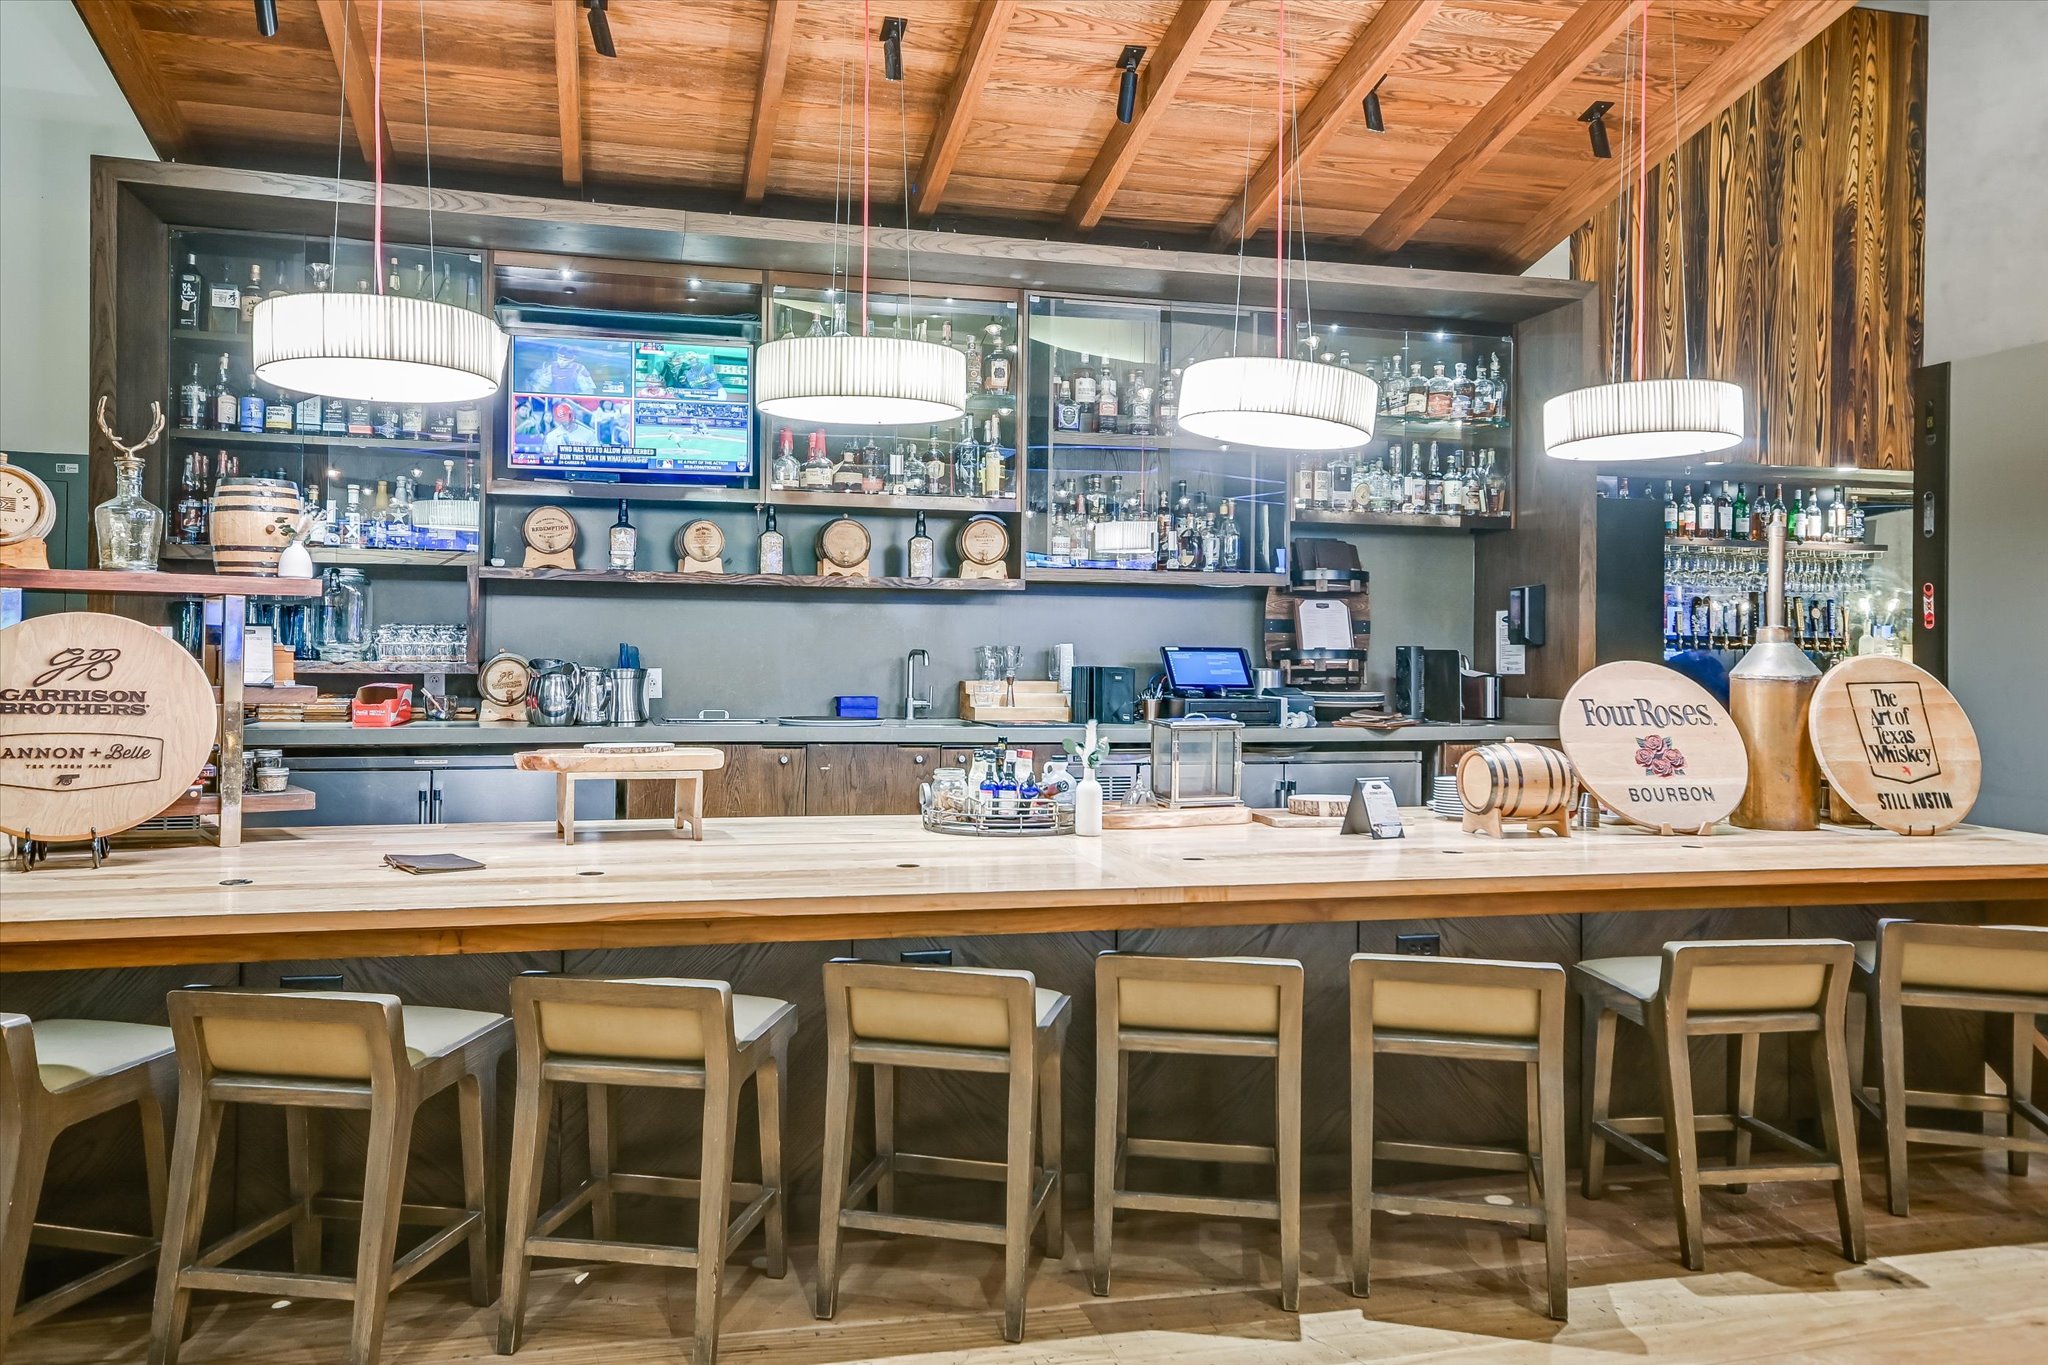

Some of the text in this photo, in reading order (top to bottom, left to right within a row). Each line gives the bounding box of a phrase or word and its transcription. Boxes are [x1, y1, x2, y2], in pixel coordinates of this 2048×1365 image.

[560, 445, 572, 453] WHO
[0, 688, 147, 703] GARRISON
[1871, 689, 1898, 707] The
[0, 702, 147, 716] BROTHERS
[1578, 698, 1637, 727] Four
[1871, 706, 1910, 726] Art of
[1872, 726, 1916, 745] Texas
[0, 747, 85, 759] ANNON
[104, 743, 152, 760] Belle
[1868, 744, 1931, 767] Whiskey
[1628, 786, 1716, 802] BOURBON
[1877, 792, 1953, 810] STILL AUSTIN
